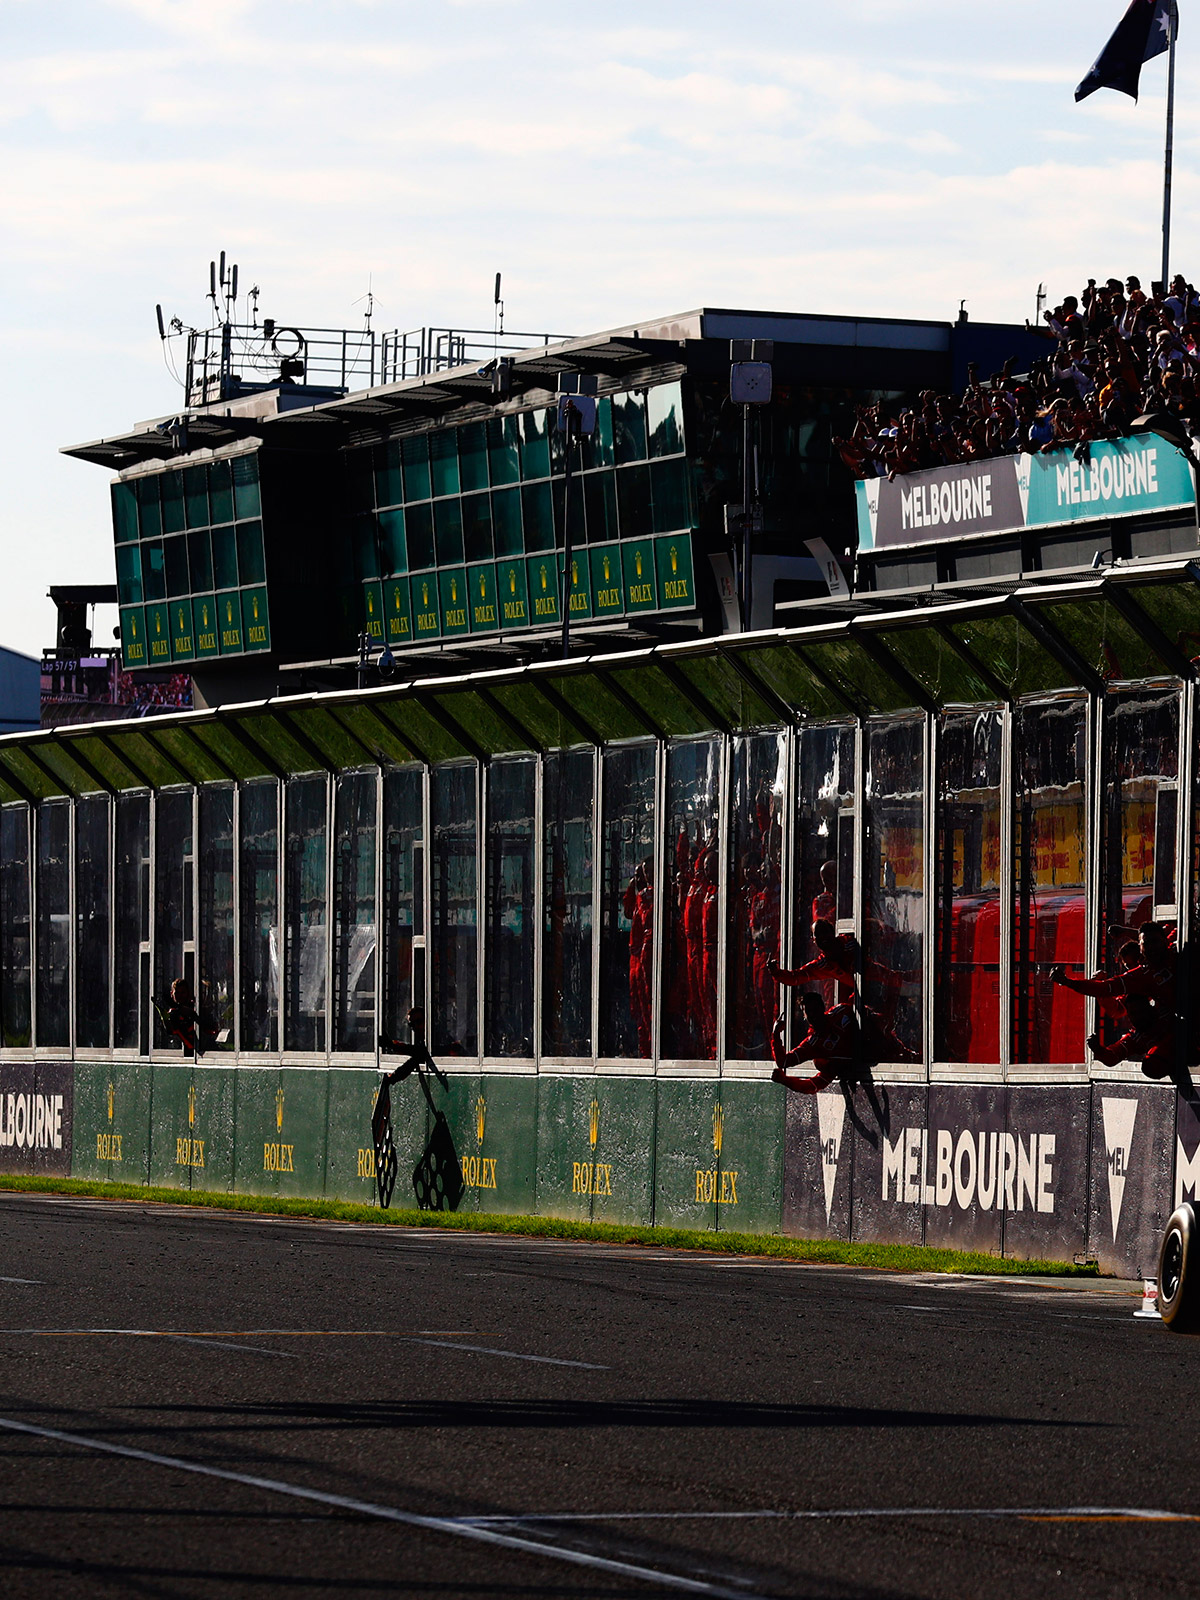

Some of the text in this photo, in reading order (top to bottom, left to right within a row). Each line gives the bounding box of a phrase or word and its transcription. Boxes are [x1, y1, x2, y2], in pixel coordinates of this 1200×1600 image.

[1056, 448, 1158, 506] MELBOURNE
[900, 474, 993, 530] MELBOURNE
[598, 588, 620, 608] ROLEX
[630, 584, 652, 603] ROLEX
[664, 580, 688, 599] ROLEX
[504, 601, 525, 619] ROLEX
[535, 597, 556, 615] ROLEX
[569, 593, 588, 611] OLEX
[417, 613, 437, 630] ROLEX
[446, 609, 465, 627] ROLEX
[474, 605, 495, 623] ROLEX
[366, 620, 382, 637] OLEX
[390, 617, 408, 634] ROLEX
[41, 661, 77, 672] Lap 57/57
[0, 1093, 63, 1149] LBOURNE
[96, 1134, 123, 1161] ROLEX
[176, 1138, 205, 1168] ROLEX
[263, 1143, 294, 1172] ROLEX
[462, 1156, 497, 1189] ROLEX
[572, 1161, 613, 1196] ROLEX
[881, 1127, 1057, 1213] MELBOURNE
[696, 1170, 739, 1204] ROLEX
